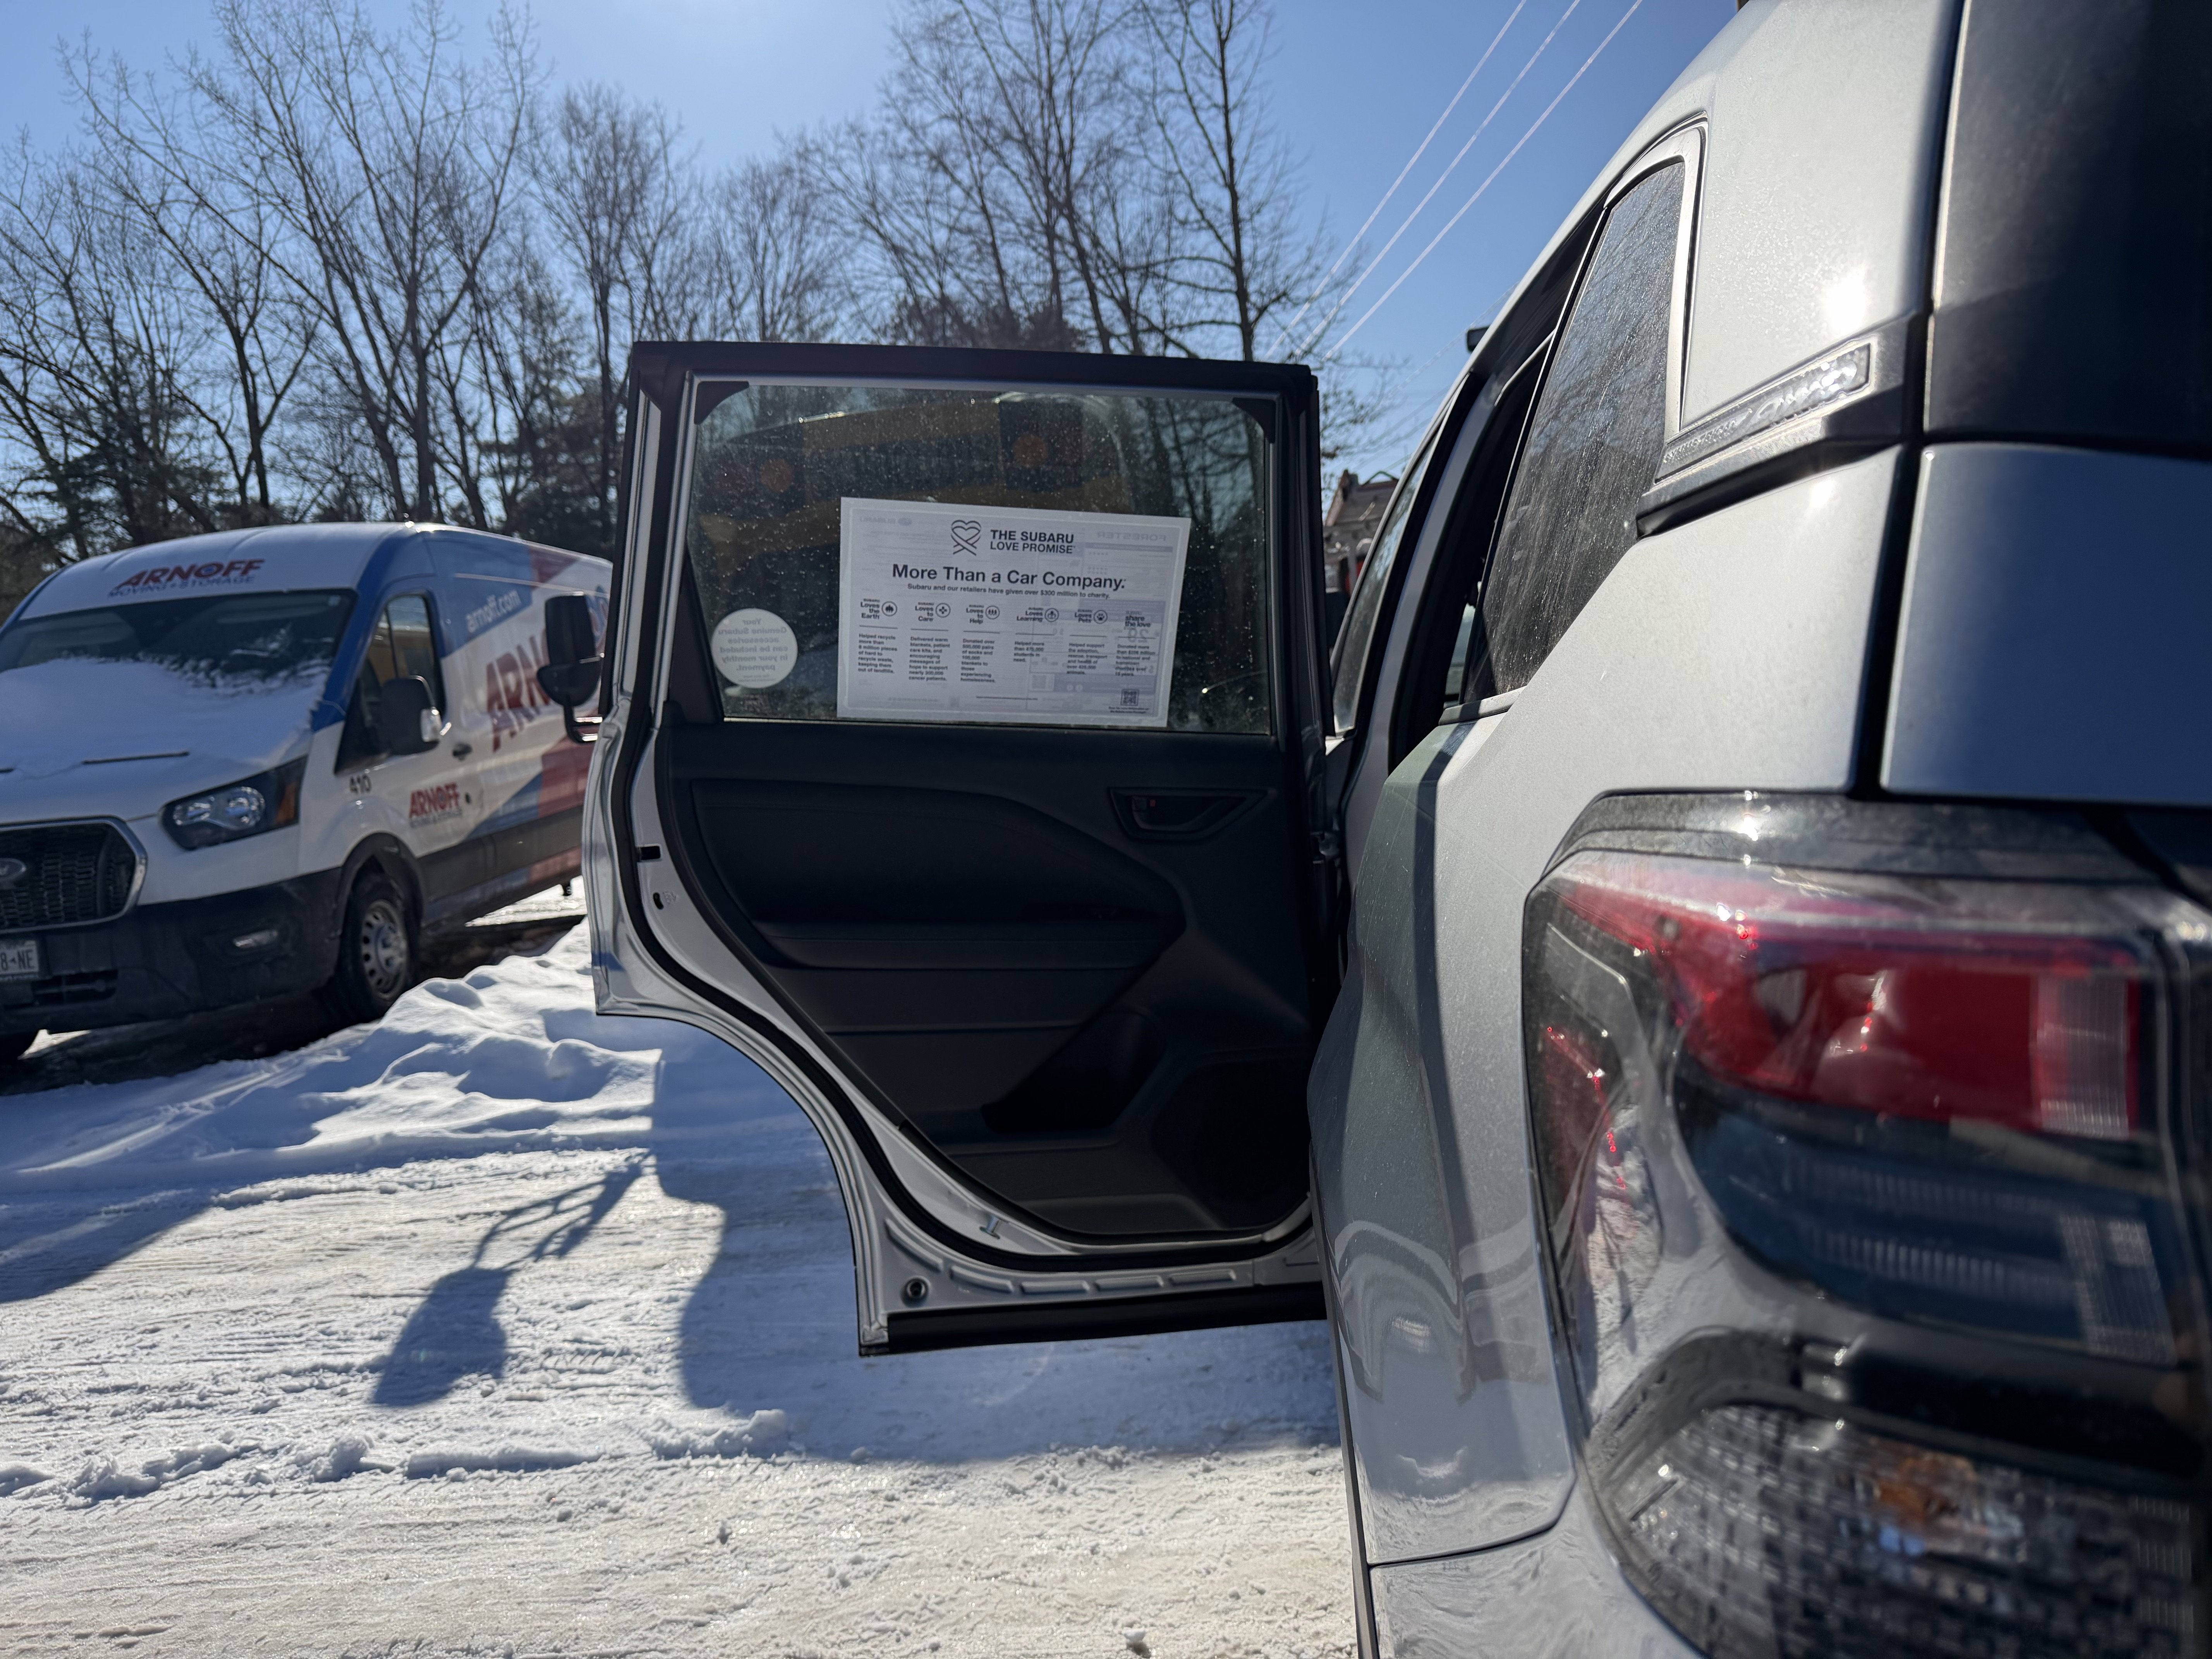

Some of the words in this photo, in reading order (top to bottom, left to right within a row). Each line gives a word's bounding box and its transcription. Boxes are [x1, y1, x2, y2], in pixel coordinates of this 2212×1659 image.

[990, 542, 1019, 551] LOVE
[1022, 543, 1072, 554] PROMISE
[991, 530, 1016, 540] THE
[1021, 531, 1074, 543] SUBARU
[110, 558, 266, 592] ARNOFF
[893, 564, 937, 579] More
[943, 566, 985, 582] Than
[991, 571, 1001, 583] a
[1007, 570, 1037, 584] Car
[1042, 571, 1125, 591] Company.
[466, 590, 522, 633] arnoff.com
[486, 627, 551, 753] ARN
[409, 782, 460, 819] ARNOFF
